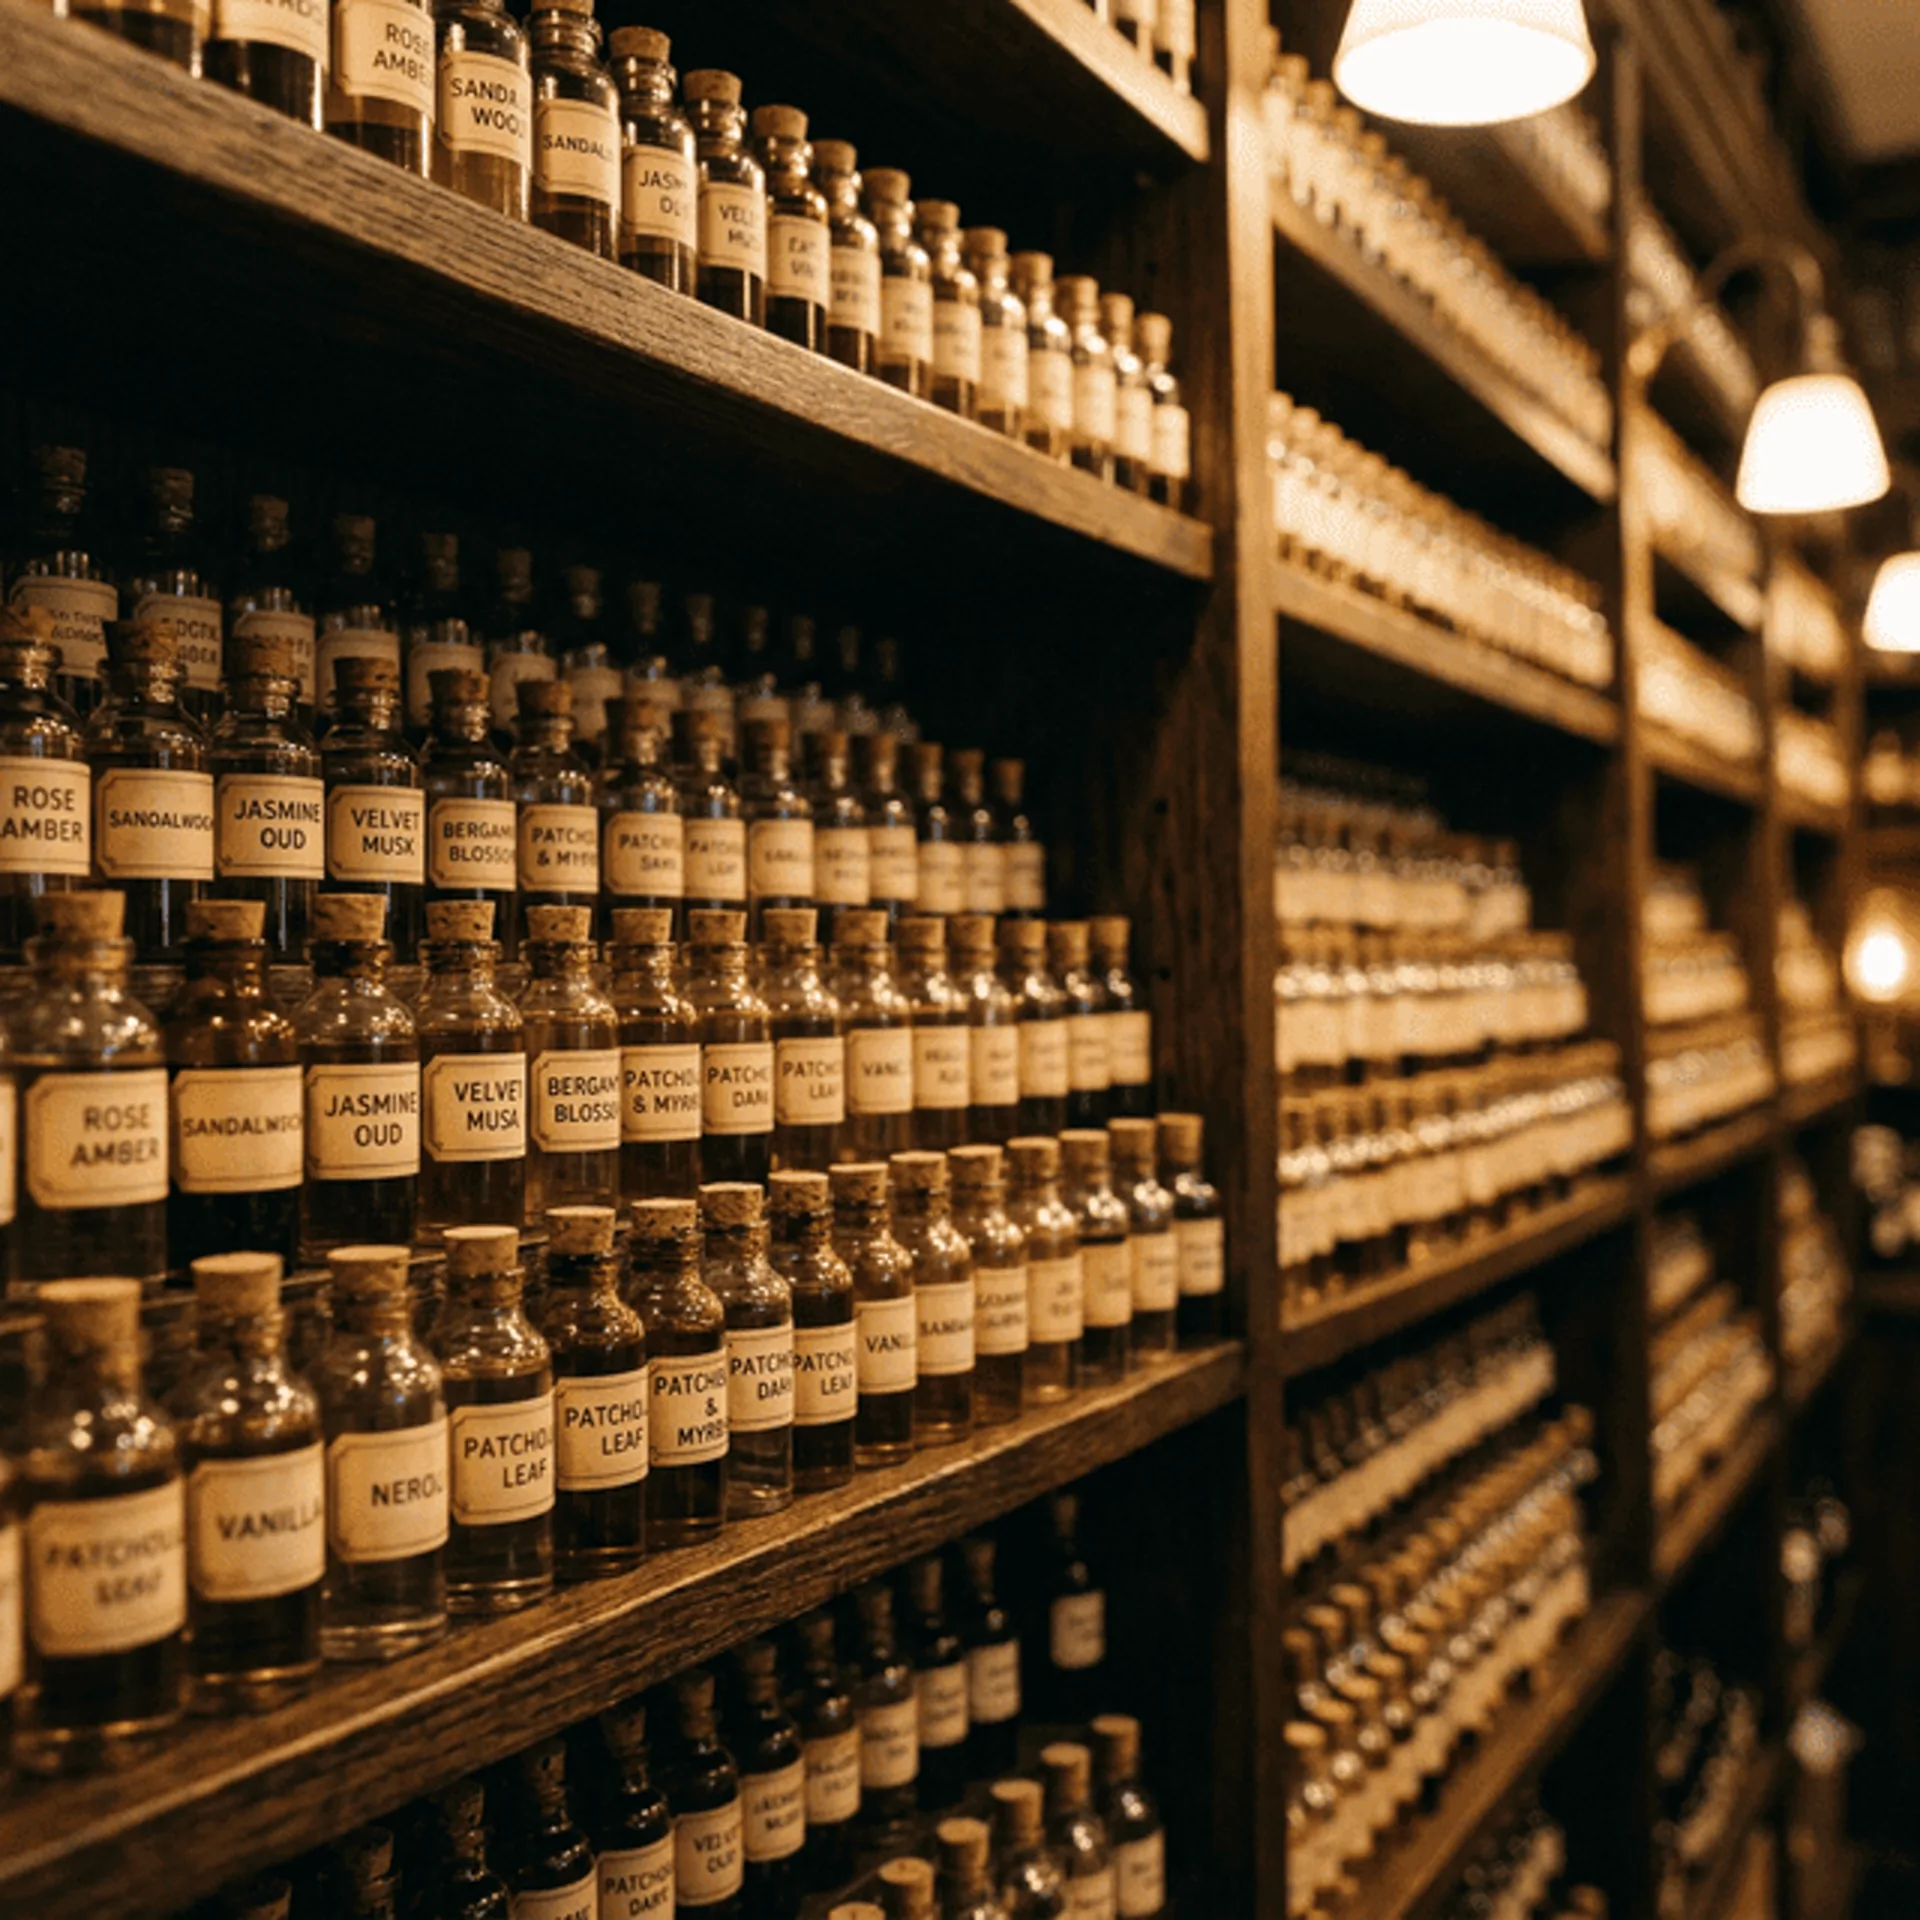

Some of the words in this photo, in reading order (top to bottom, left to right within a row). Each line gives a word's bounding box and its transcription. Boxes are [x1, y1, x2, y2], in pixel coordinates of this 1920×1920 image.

[13, 785, 76, 812] ROSE
[234, 800, 321, 824] JASMINE
[0, 816, 84, 843] AMBER
[351, 808, 420, 831] VELVET
[260, 827, 306, 850] OUD
[83, 1103, 151, 1132] ROSE
[324, 1091, 418, 1117] JASMINE
[632, 1096, 646, 1114] &
[354, 1122, 403, 1147] OUD
[70, 1137, 160, 1168] AMBER
[565, 1399, 646, 1429] PATCHO
[705, 1397, 718, 1417] &
[464, 1427, 549, 1460] PATCHO
[602, 1427, 643, 1456] LEAF
[503, 1458, 547, 1490] LEAF
[371, 1473, 442, 1507] NERO
